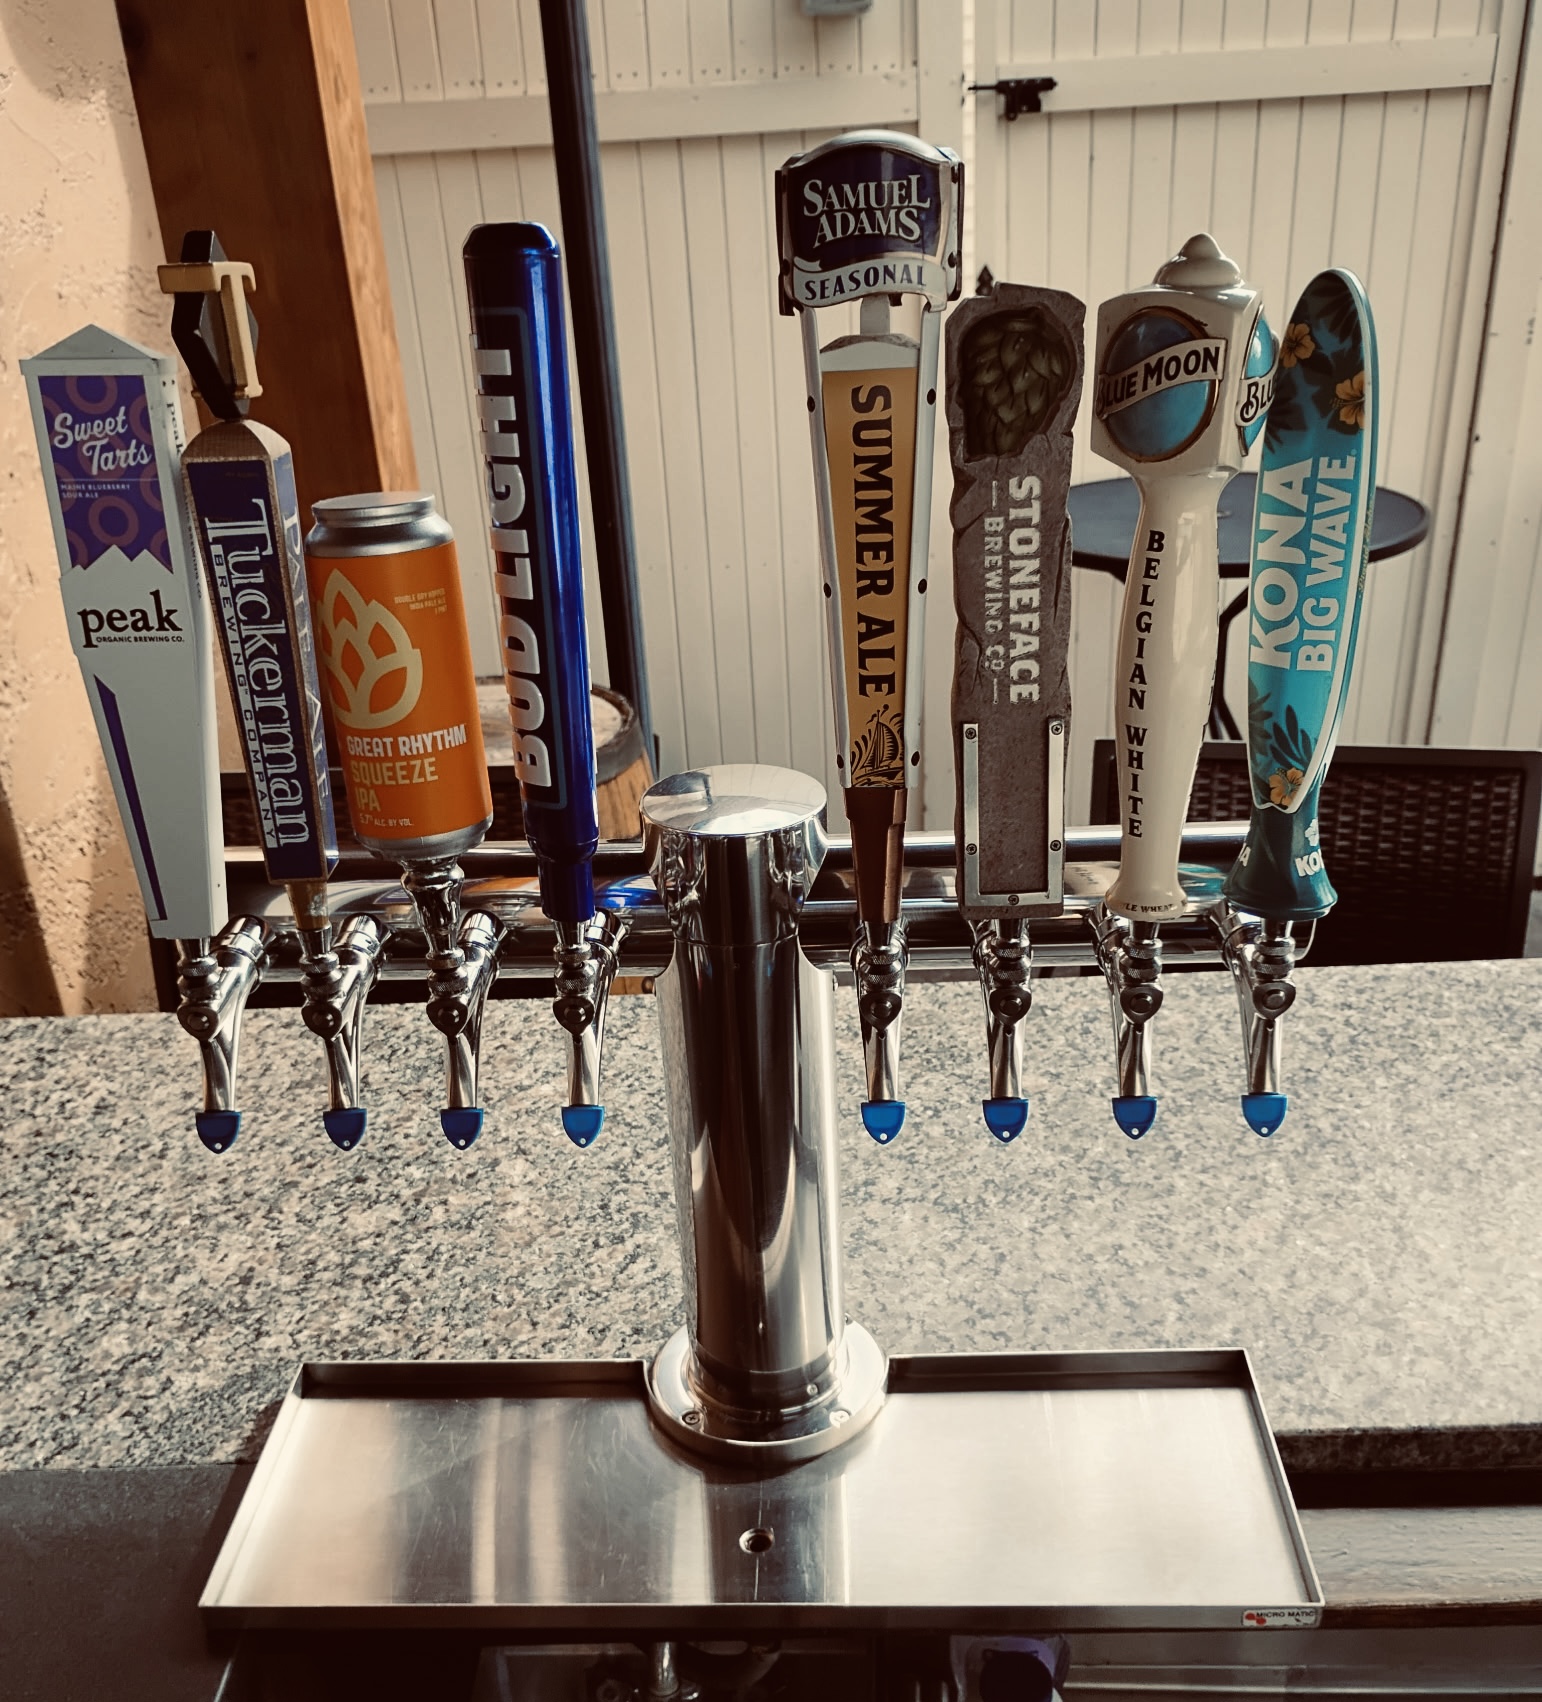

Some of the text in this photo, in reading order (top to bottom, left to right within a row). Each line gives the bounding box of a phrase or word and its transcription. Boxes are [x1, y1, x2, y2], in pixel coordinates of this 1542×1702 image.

[803, 174, 931, 217] SAMUEL
[813, 207, 921, 249] ADAMS
[804, 263, 927, 301] SEASONAL
[1141, 346, 1220, 393] MOON
[1240, 379, 1273, 423] BLU
[53, 405, 128, 449] Sweet
[82, 437, 152, 476] Tarts
[60, 483, 130, 491] MAINE BLUEBERRY
[469, 332, 552, 789] BUD LIGHT
[850, 384, 896, 699] SUMMER ALE
[1250, 457, 1313, 669] KONA
[983, 516, 1004, 635] BREWING
[1008, 474, 1042, 705] STONEFACE
[77, 589, 183, 648] peak
[171, 635, 185, 643] CO.
[1296, 597, 1339, 672] BIG
[204, 498, 310, 848] Tuckerman
[283, 507, 328, 806] PALE ALE
[1125, 529, 1166, 839] BELGIAN WHITE
[345, 724, 467, 757] GREAT RHYTHM
[243, 709, 277, 842] COMPANY
[350, 757, 439, 786] SQUEEZE
[354, 787, 381, 812] IPA
